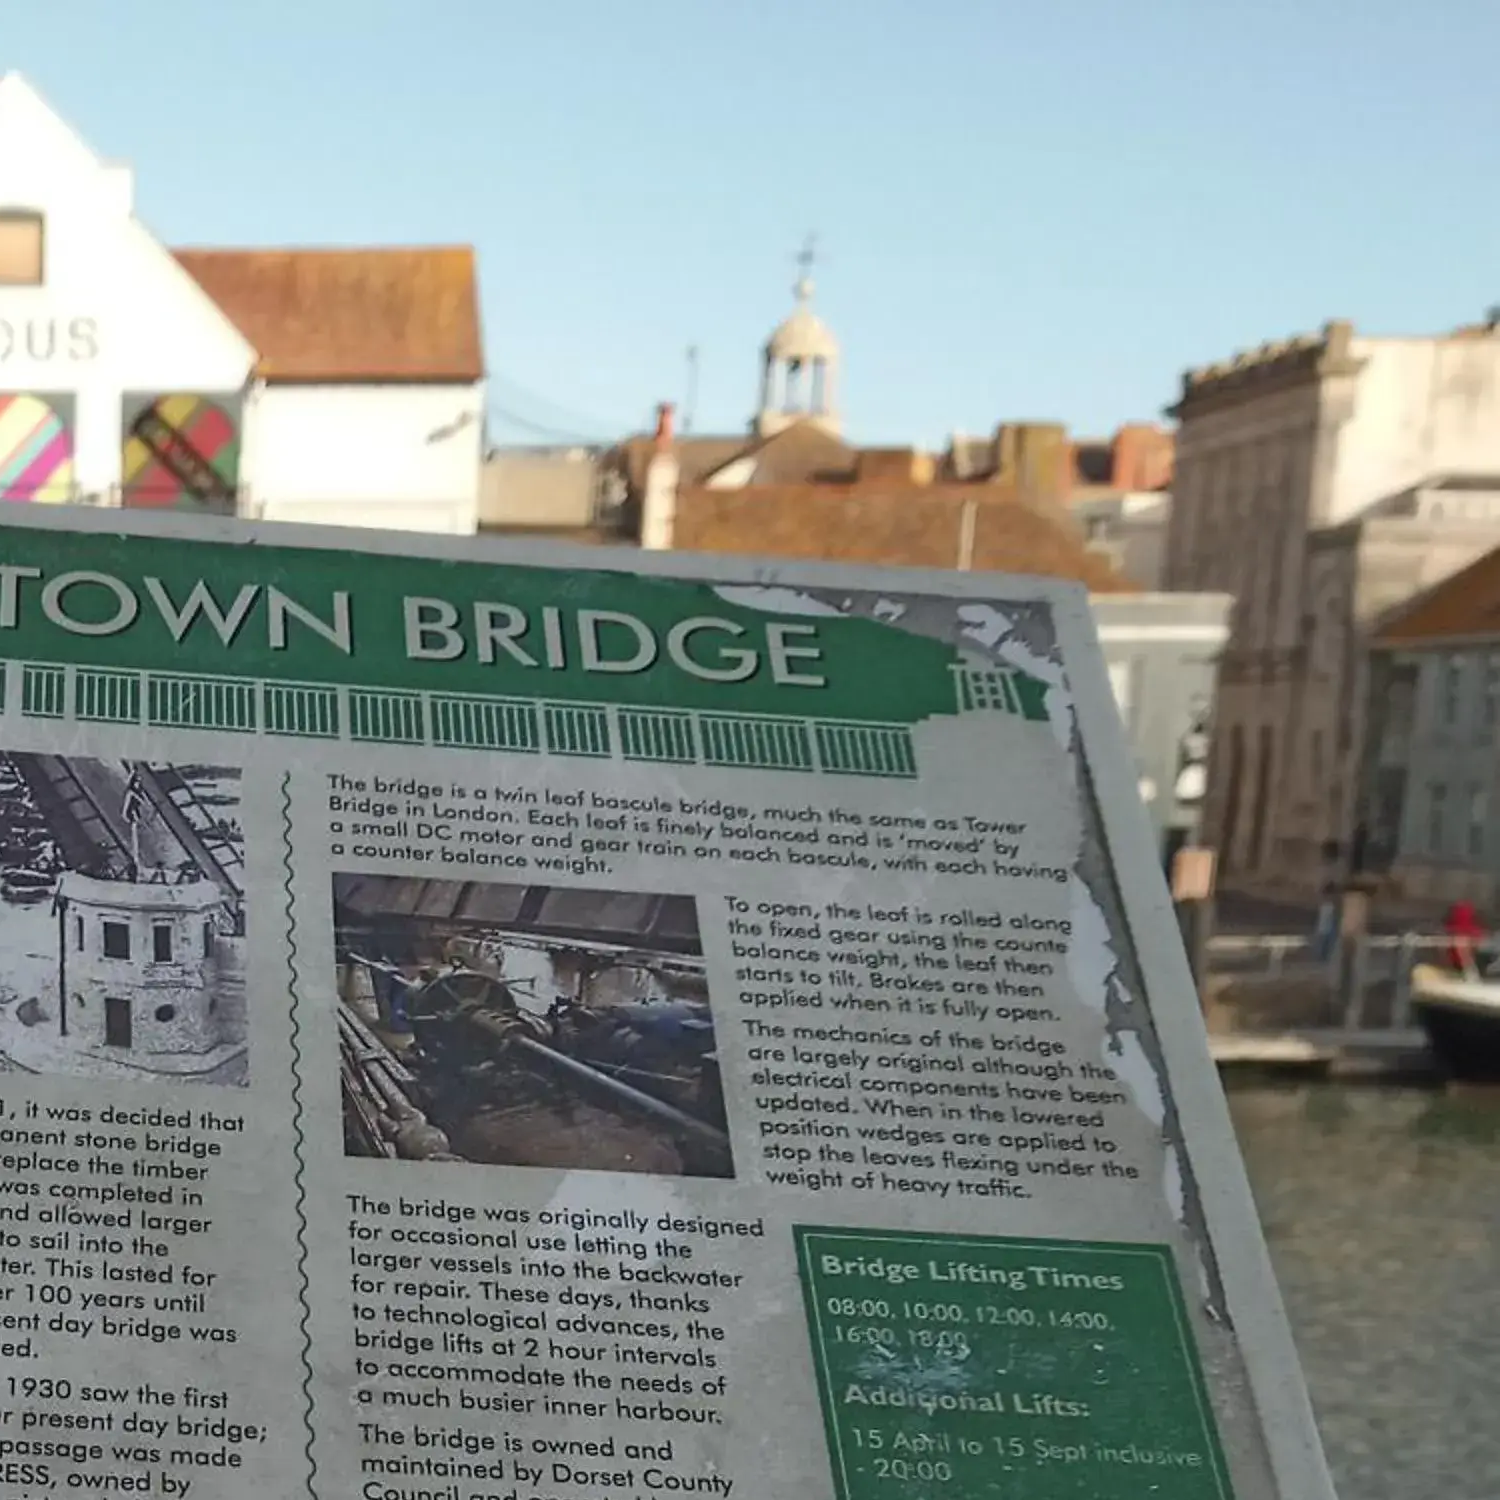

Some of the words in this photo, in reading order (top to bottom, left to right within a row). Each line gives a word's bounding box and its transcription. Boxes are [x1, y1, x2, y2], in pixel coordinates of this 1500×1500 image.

[404, 596, 828, 688] BRIDGE
[329, 842, 345, 855] a
[351, 844, 435, 862] counter
[438, 844, 528, 868] balance
[749, 1065, 852, 1090] electrical
[858, 1078, 1000, 1099] components
[1004, 1079, 1063, 1103] have
[1066, 1083, 1127, 1104] been
[25, 1099, 39, 1119] it
[44, 1106, 92, 1123] was
[98, 1103, 191, 1129] decided
[198, 1110, 244, 1132] that
[764, 1166, 844, 1191] weight
[849, 1170, 875, 1189] of
[879, 1170, 952, 1199] heavy
[344, 1193, 391, 1215] The
[398, 1195, 476, 1224] bridge
[482, 1207, 531, 1223] was
[537, 1206, 649, 1235] originally
[655, 1211, 764, 1239] designed
[44, 1256, 94, 1280] This
[101, 1259, 173, 1284] lasted
[180, 1264, 217, 1287] for
[821, 1255, 920, 1283] Bridge
[928, 1260, 1027, 1291] Lifting
[1027, 1265, 1124, 1290] Times
[351, 1302, 376, 1321] to
[382, 1302, 547, 1333] technological
[554, 1312, 679, 1342] advances,
[685, 1318, 725, 1341] the
[6, 1375, 72, 1400] 1930
[79, 1386, 129, 1403] saw
[135, 1382, 175, 1407] the
[182, 1385, 228, 1409] first
[1013, 1392, 1092, 1417] Lifts:
[852, 1427, 883, 1448] 15
[893, 1431, 950, 1453] April
[959, 1437, 983, 1455] to
[992, 1436, 1025, 1457] 15
[1033, 1438, 1087, 1463] Sept
[1093, 1442, 1202, 1466] inclusive
[66, 1469, 151, 1492] owned
[160, 1470, 191, 1500] by
[360, 1454, 504, 1480] maintained
[512, 1458, 543, 1487] by
[551, 1462, 634, 1488] Dorset
[642, 1467, 733, 1498] County
[873, 1458, 952, 1481] 20:00
